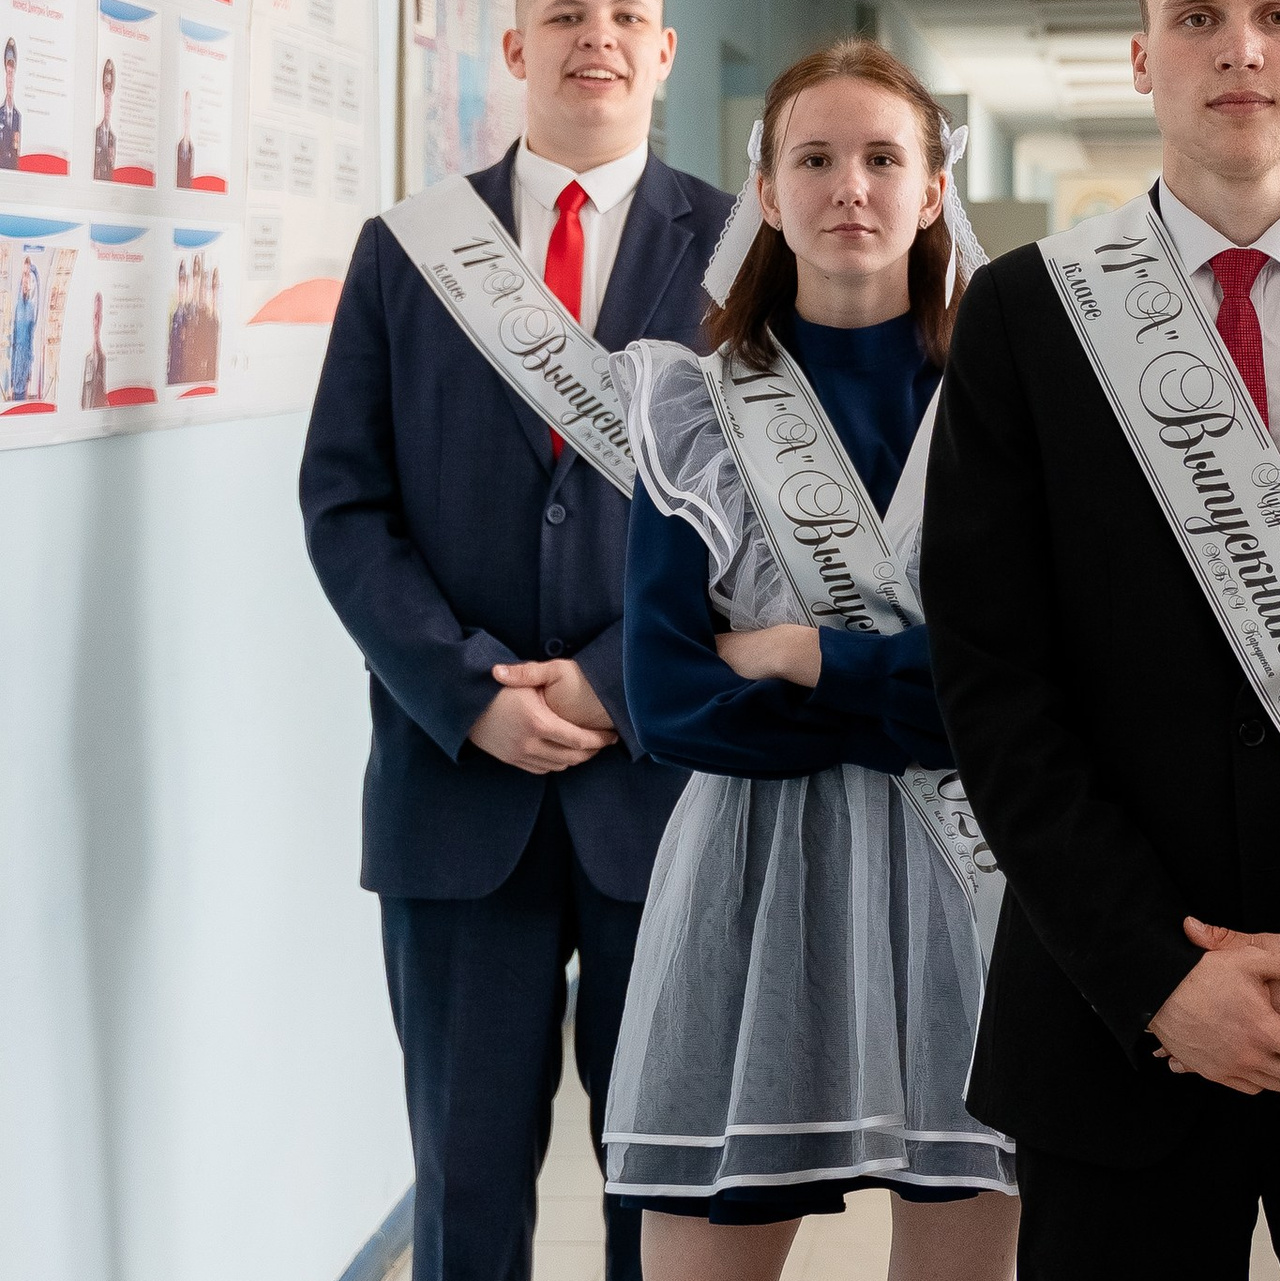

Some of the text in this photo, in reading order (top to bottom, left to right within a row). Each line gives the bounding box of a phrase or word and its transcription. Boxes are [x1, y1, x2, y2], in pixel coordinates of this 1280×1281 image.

[1062, 262, 1102, 321] класс
[500, 304, 636, 463] Выпускн
[779, 470, 880, 634] Выпус
